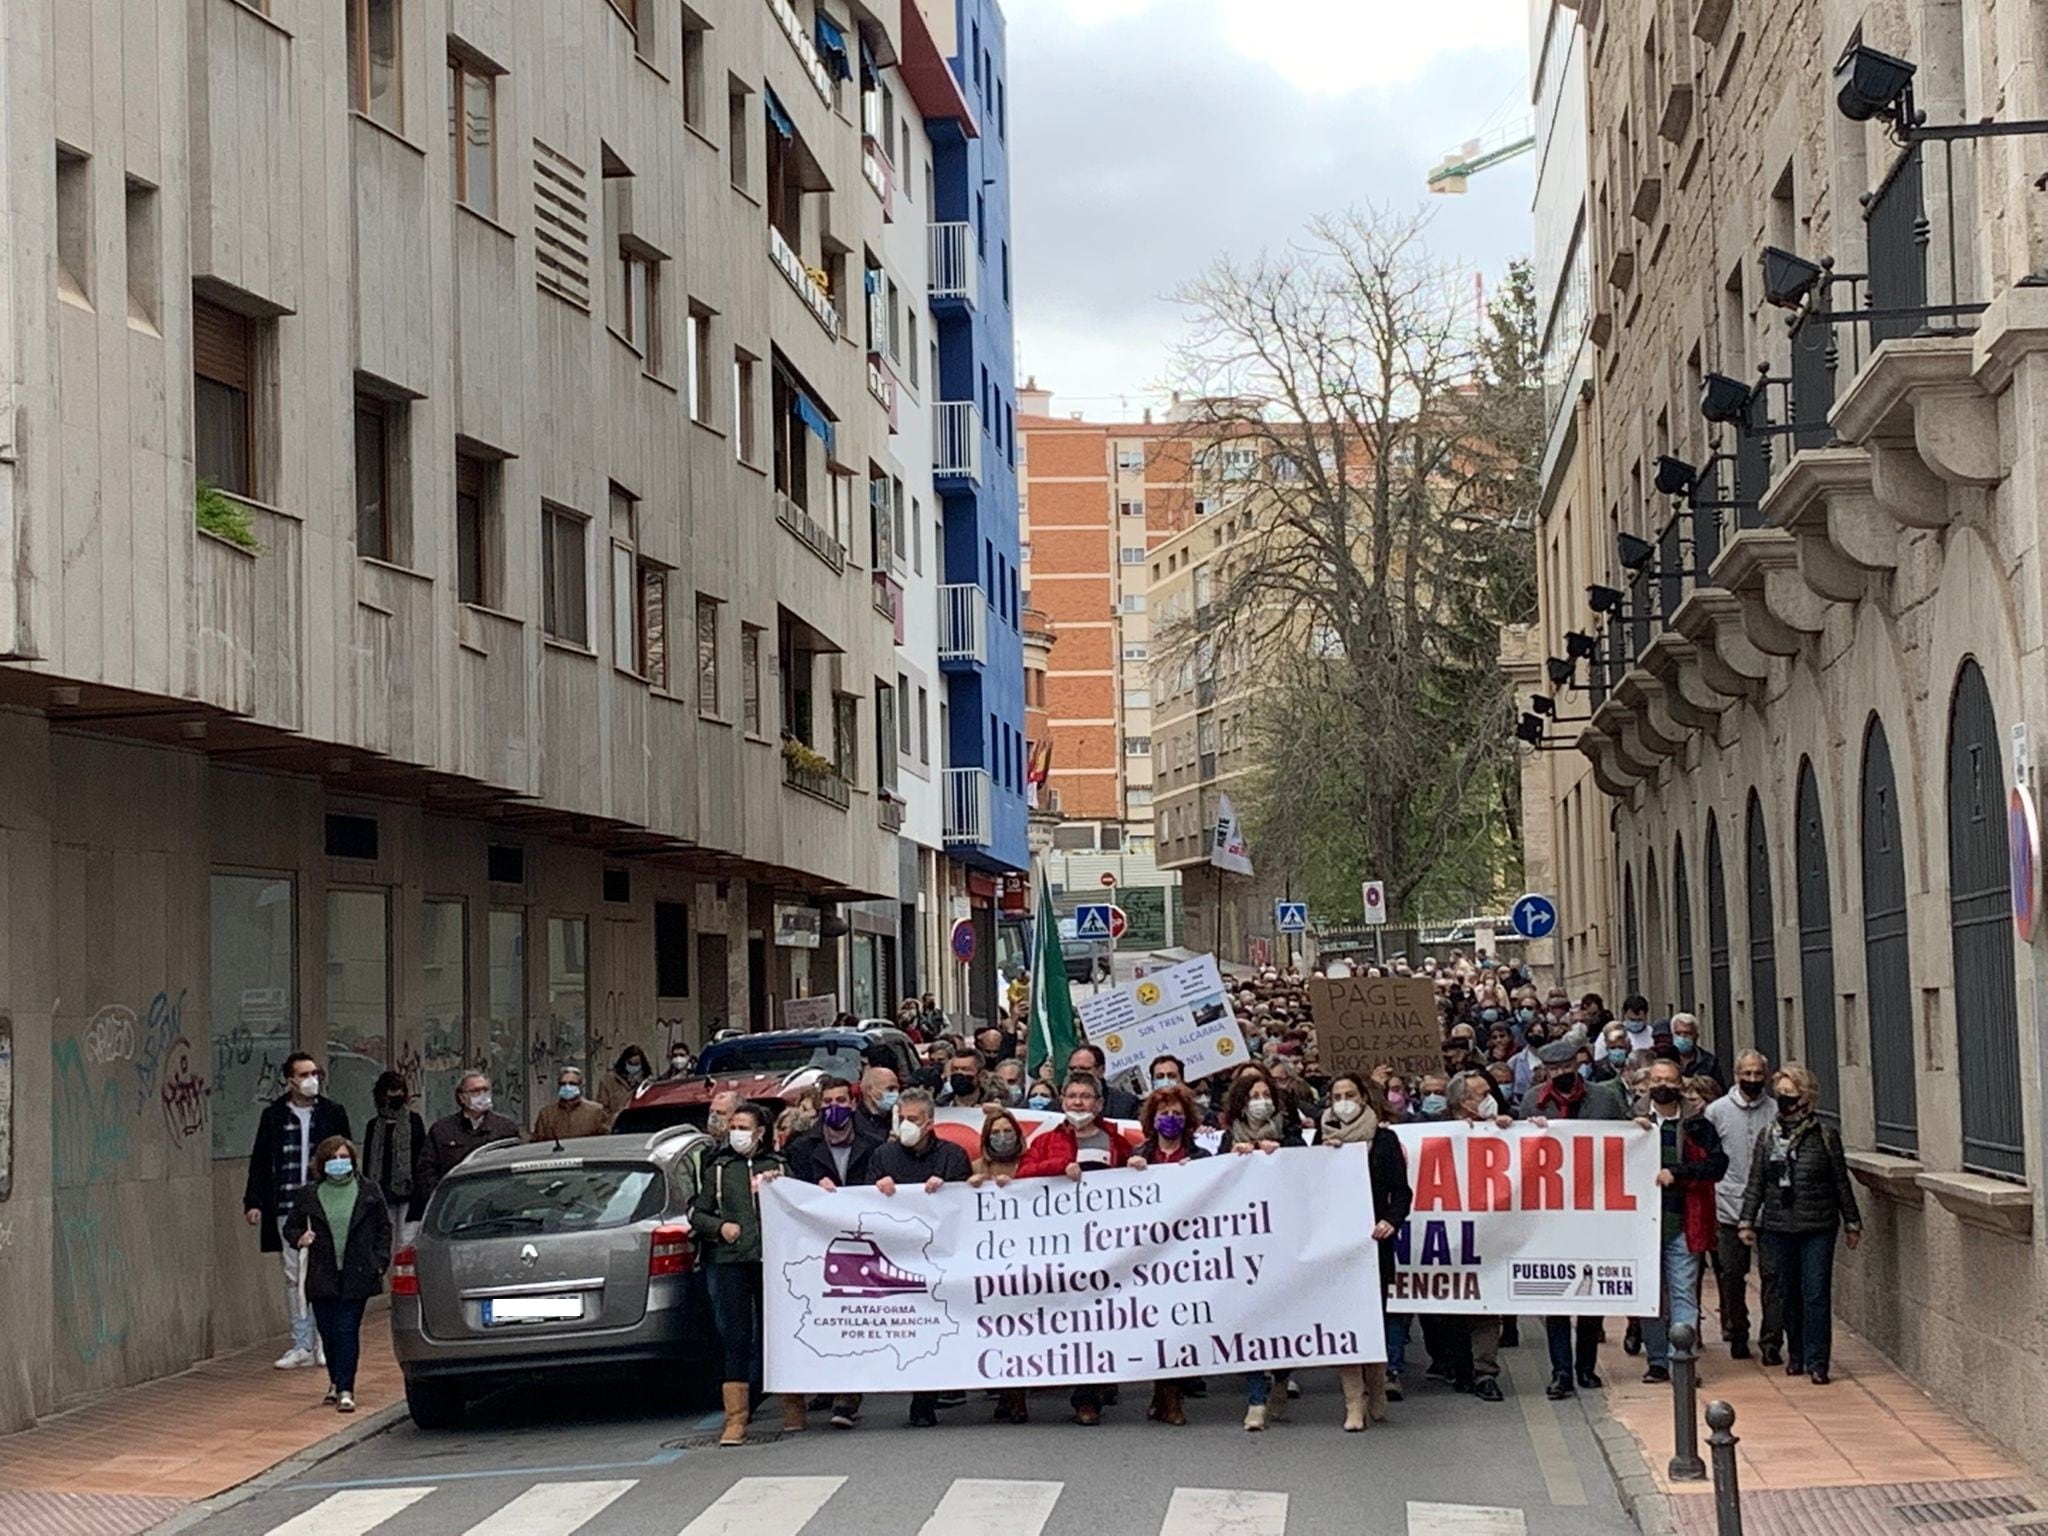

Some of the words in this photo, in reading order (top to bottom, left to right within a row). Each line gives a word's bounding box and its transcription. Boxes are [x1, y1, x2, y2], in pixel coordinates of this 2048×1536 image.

[1328, 982, 1411, 1011] PAGE
[1138, 1025, 1156, 1037] SIN
[1158, 1014, 1185, 1031] TREN
[1339, 1010, 1423, 1030] CHANA
[1111, 1050, 1146, 1070] MUERE
[1156, 1042, 1169, 1054] LA
[1178, 1022, 1226, 1047] ALCARRIA
[1404, 1136, 1638, 1212] ARRIL
[975, 1191, 1020, 1222] En
[1032, 1180, 1162, 1218] defensa
[976, 1230, 1016, 1261] de
[1029, 1231, 1070, 1257] un
[1084, 1201, 1273, 1253] ferrocarril
[974, 1262, 1122, 1304] público,
[1132, 1246, 1236, 1287] social
[1243, 1254, 1265, 1285] y
[1386, 1272, 1482, 1301] ENCIA
[1512, 1264, 1577, 1280] PUEBLOS
[1597, 1266, 1620, 1278] CON
[1621, 1266, 1632, 1278] EL
[1597, 1280, 1633, 1296] TREN
[840, 1305, 916, 1314] PLATAFORMA
[891, 1317, 940, 1326] MANCHA
[977, 1296, 1159, 1339] sostenible
[1171, 1300, 1214, 1327] en
[841, 1330, 865, 1339] POR
[868, 1330, 882, 1339] EL
[886, 1330, 916, 1339] TREN
[977, 1342, 1117, 1380] Castilla
[1156, 1338, 1201, 1370] La
[1211, 1323, 1359, 1365] Mancha
